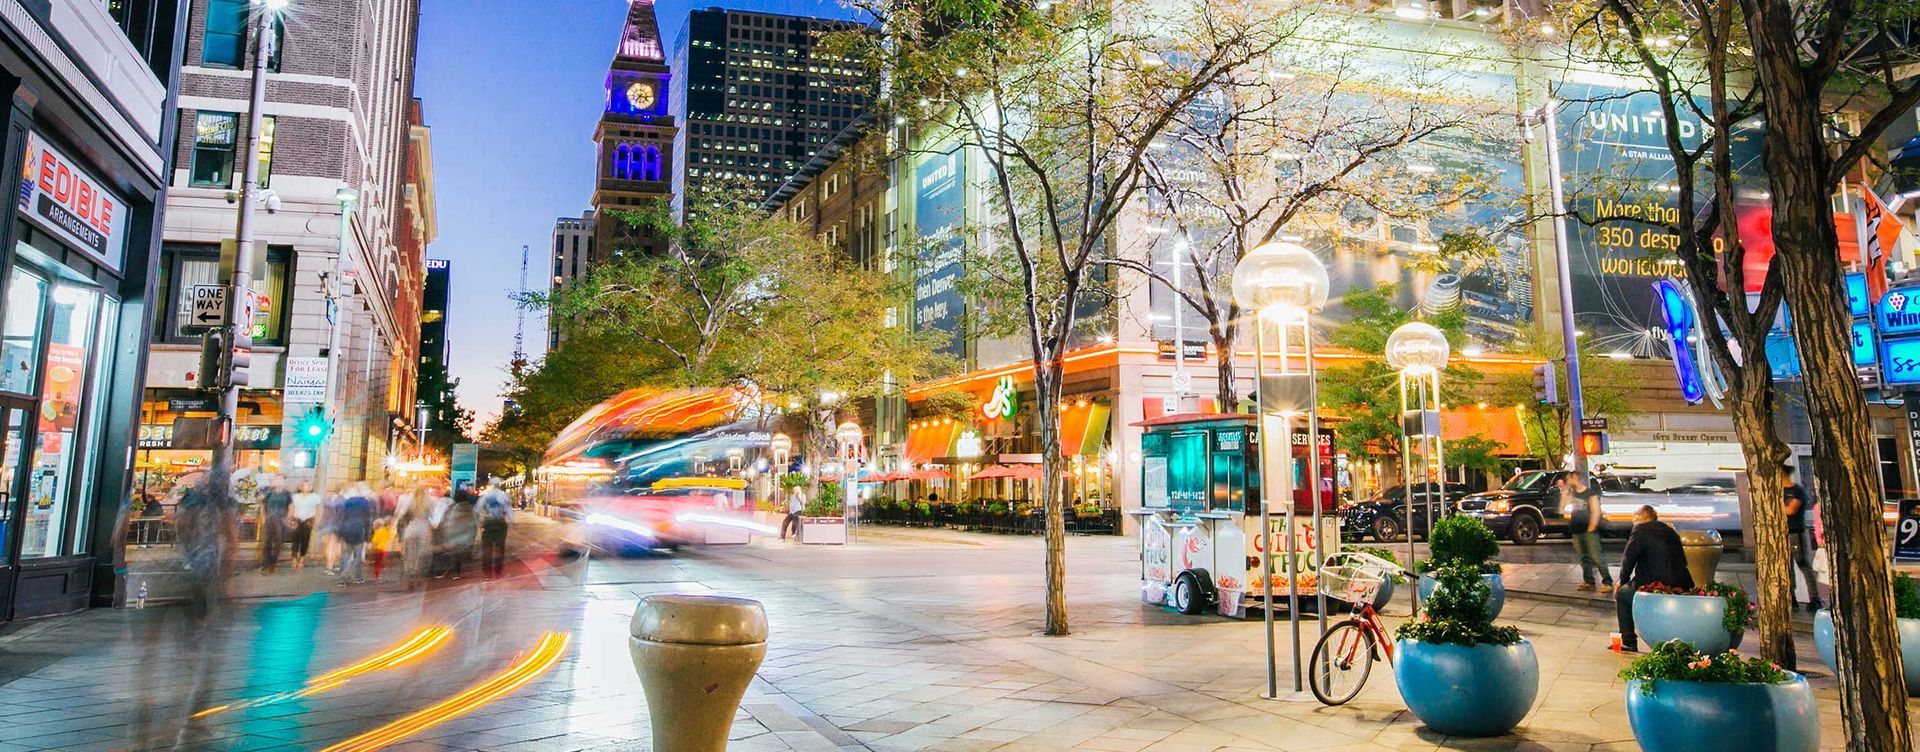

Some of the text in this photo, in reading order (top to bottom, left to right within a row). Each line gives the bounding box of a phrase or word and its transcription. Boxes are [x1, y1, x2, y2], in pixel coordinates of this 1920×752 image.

[1648, 153, 1674, 161] ALLIAN
[923, 164, 948, 189] UNITED
[39, 149, 113, 236] EDIBLE
[1597, 199, 1641, 218] More
[49, 205, 100, 248] ARRANGEMENTS
[1600, 227, 1634, 248] 350
[426, 260, 448, 269] EDU
[1601, 256, 1688, 278] worldwid
[198, 288, 223, 299] ONE
[931, 273, 956, 296] Denver
[196, 300, 223, 310] WAY
[917, 307, 923, 325] is
[1886, 311, 1920, 327] Win
[1673, 432, 1697, 441] STREET
[1701, 433, 1728, 442] CENTER
[1270, 518, 1287, 533] TH
